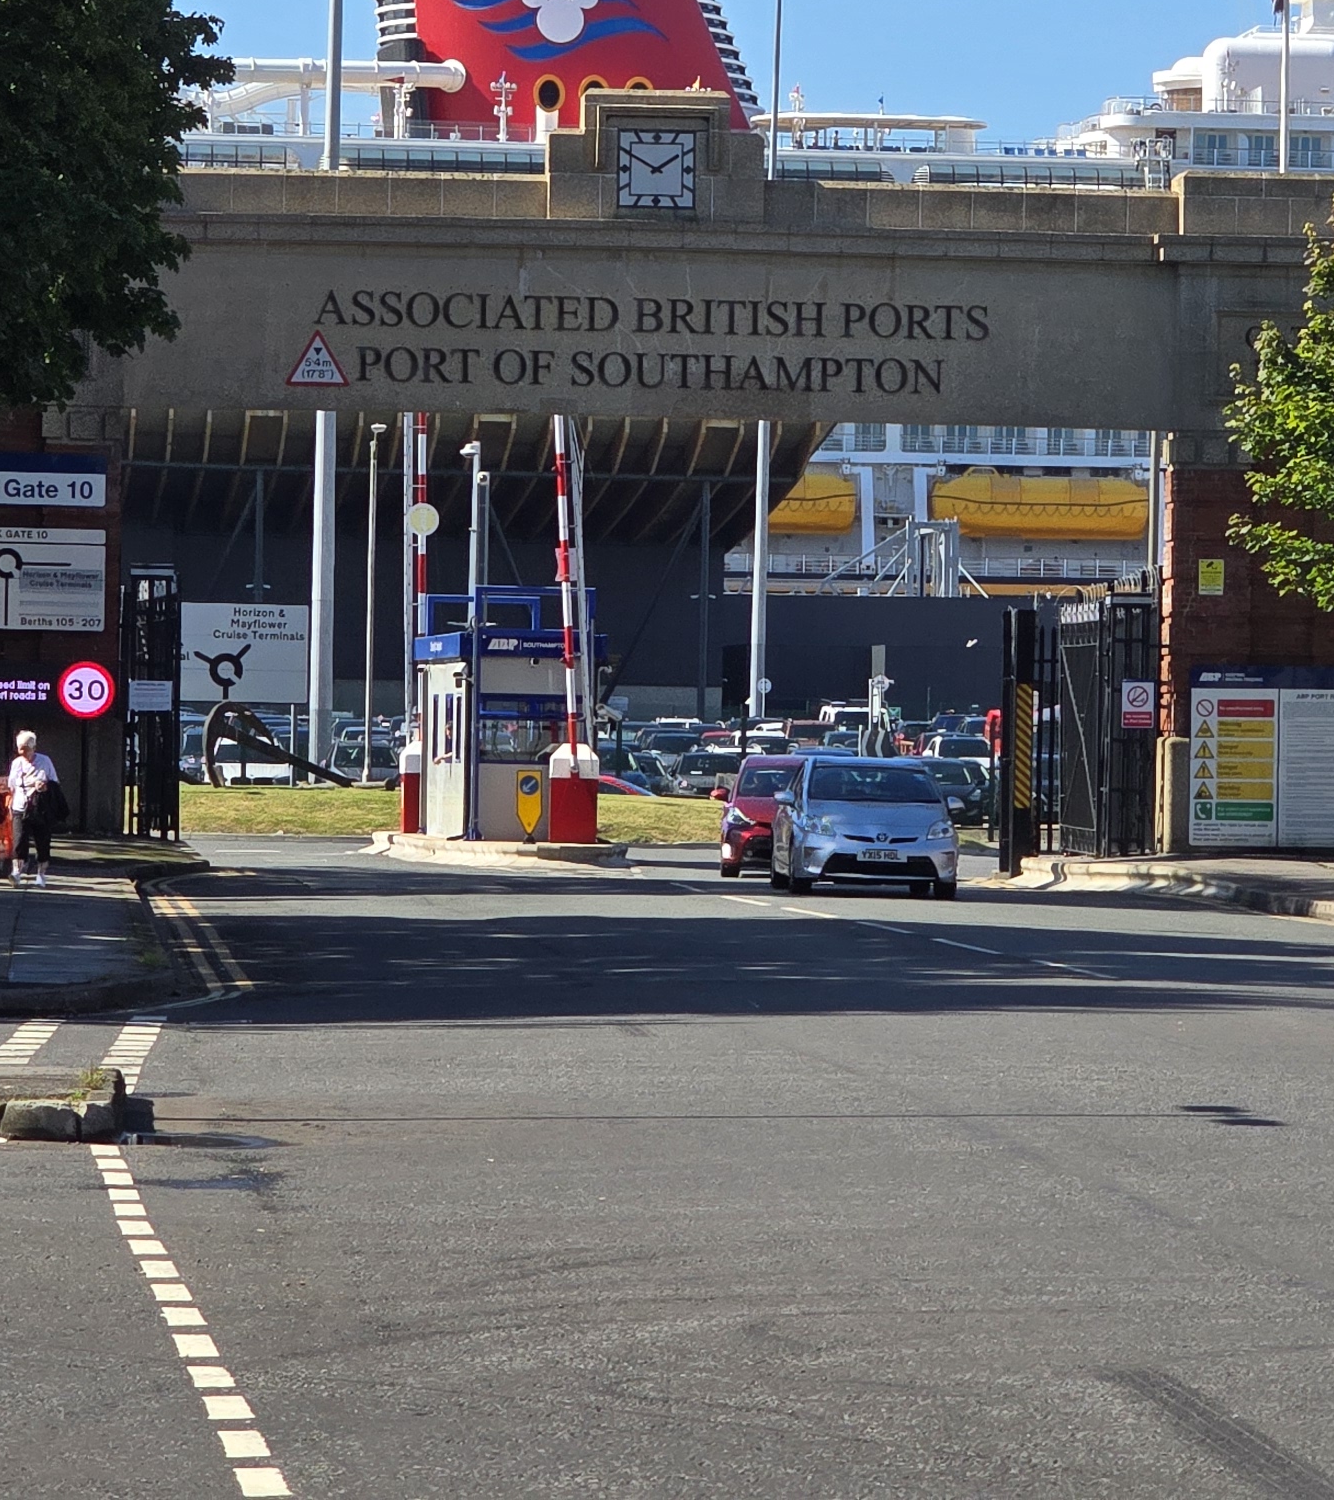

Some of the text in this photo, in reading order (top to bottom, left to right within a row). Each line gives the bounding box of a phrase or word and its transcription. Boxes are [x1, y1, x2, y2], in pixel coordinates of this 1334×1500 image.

[313, 289, 990, 341] ASSOCIATED BRITISH PORTS
[355, 346, 944, 394] PORT OF SOUTHAMPTON
[4, 479, 59, 498] Gate
[67, 481, 93, 499] 10
[5, 530, 33, 539] GATE
[36, 531, 48, 539] 10
[61, 572, 99, 580] Mayflower
[233, 607, 285, 617] Horizon &
[21, 617, 53, 626] Berths
[231, 619, 287, 630] Mayflower
[213, 630, 305, 640] Cruise Terminals
[487, 638, 518, 650] ABP
[17, 681, 35, 690] limit
[38, 682, 50, 690] on
[68, 679, 105, 700] 30
[9, 691, 35, 700] roads
[38, 691, 47, 700] is
